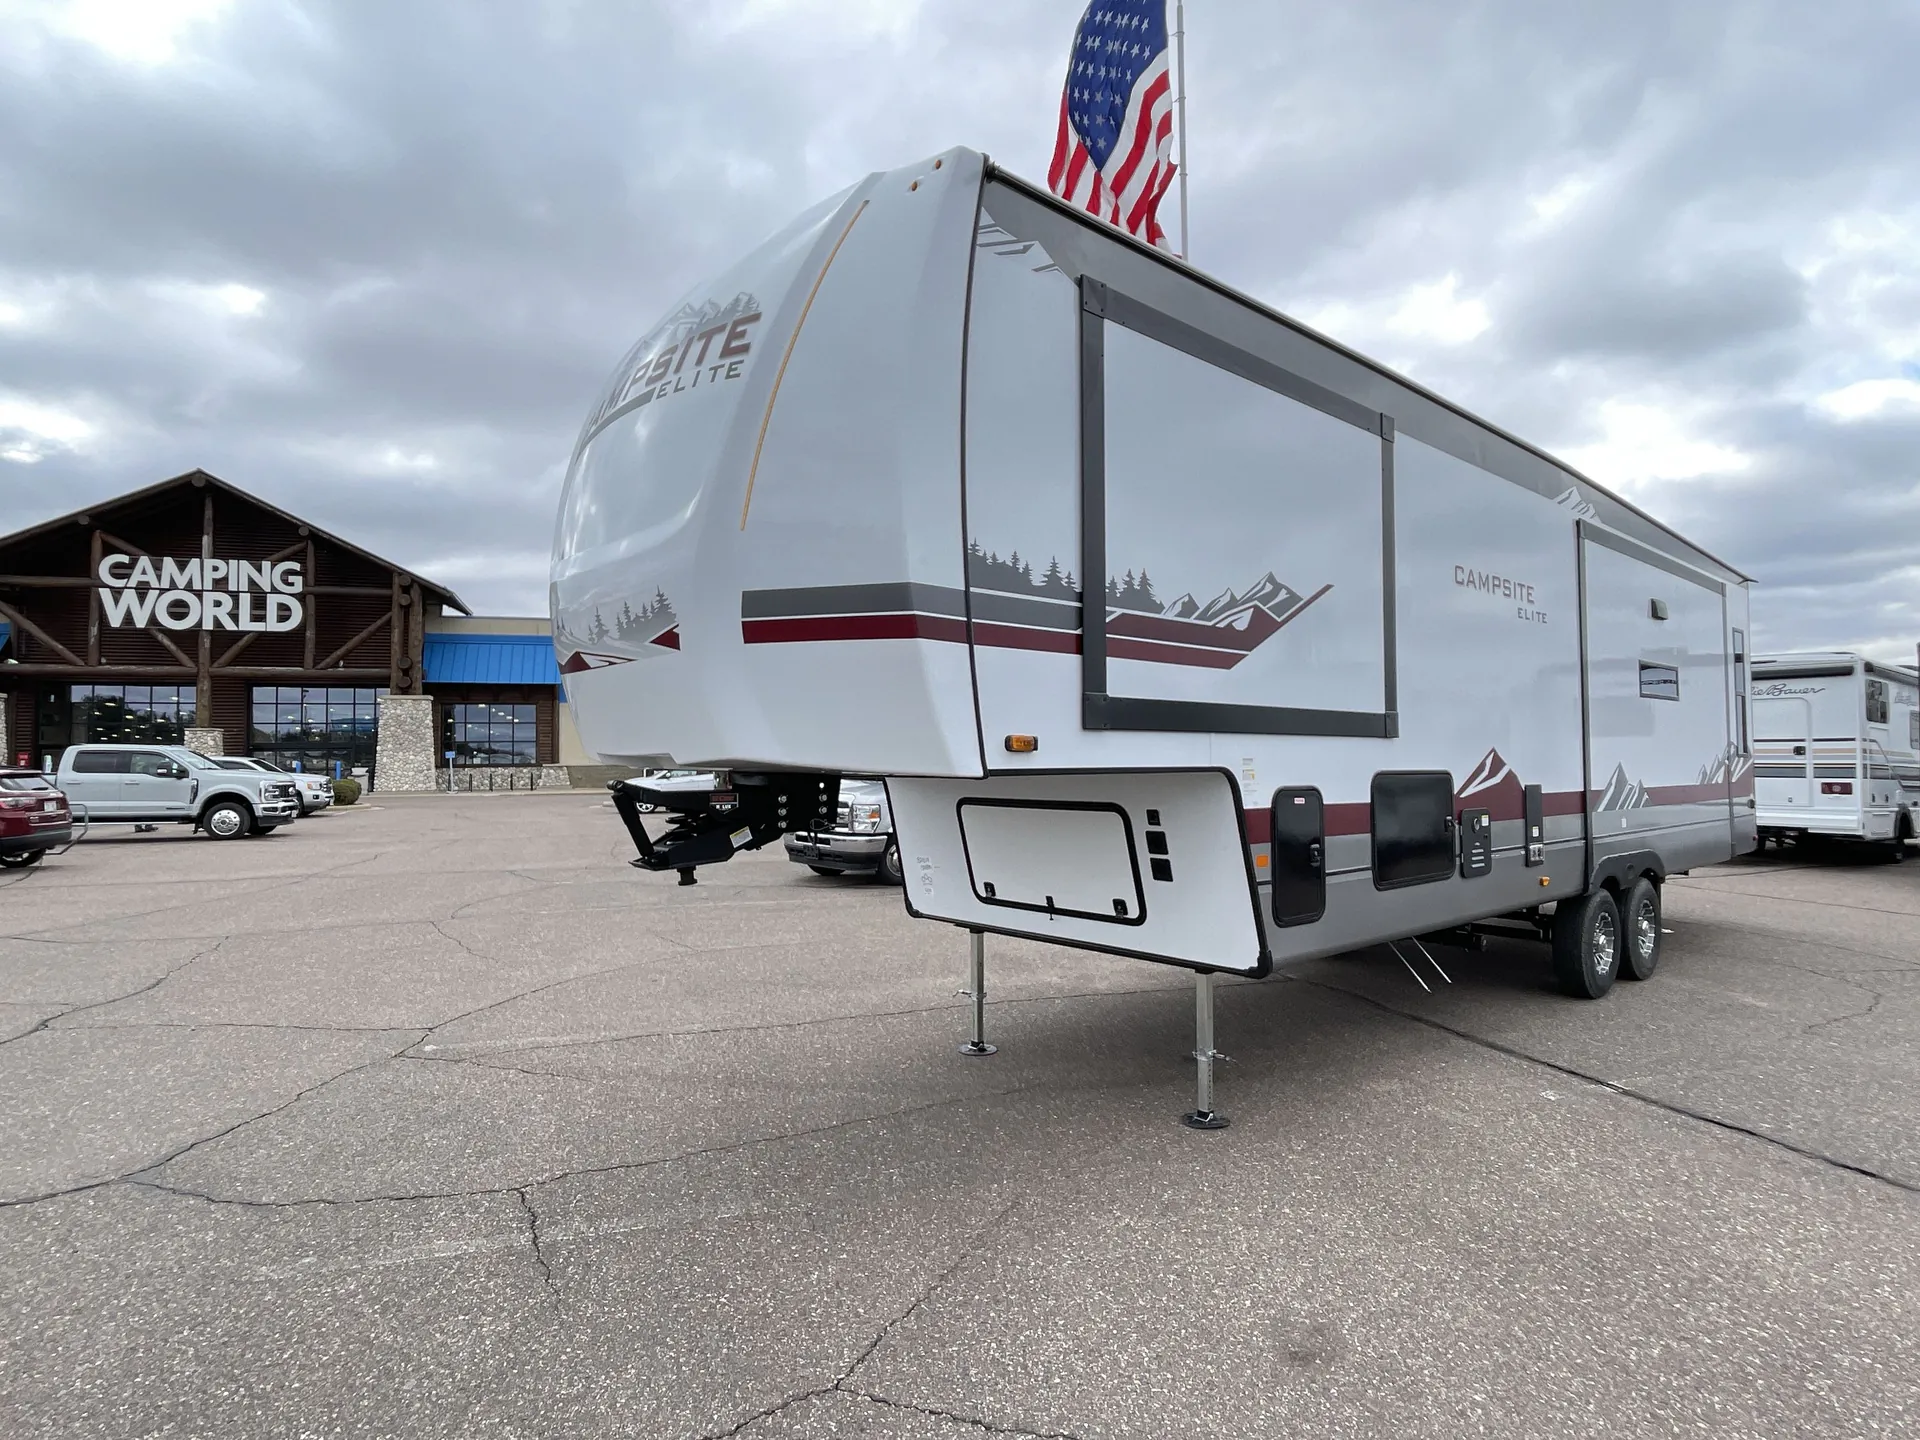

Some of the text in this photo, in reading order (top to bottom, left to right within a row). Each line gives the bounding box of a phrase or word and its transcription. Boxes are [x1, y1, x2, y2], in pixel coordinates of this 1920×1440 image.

[655, 359, 745, 400] ELITE
[98, 553, 303, 594] CAMPING
[1454, 565, 1535, 604] CAMPSITE
[98, 587, 303, 632] WORLD
[1517, 607, 1548, 624] ELITE
[1766, 683, 1826, 697] Bauer
